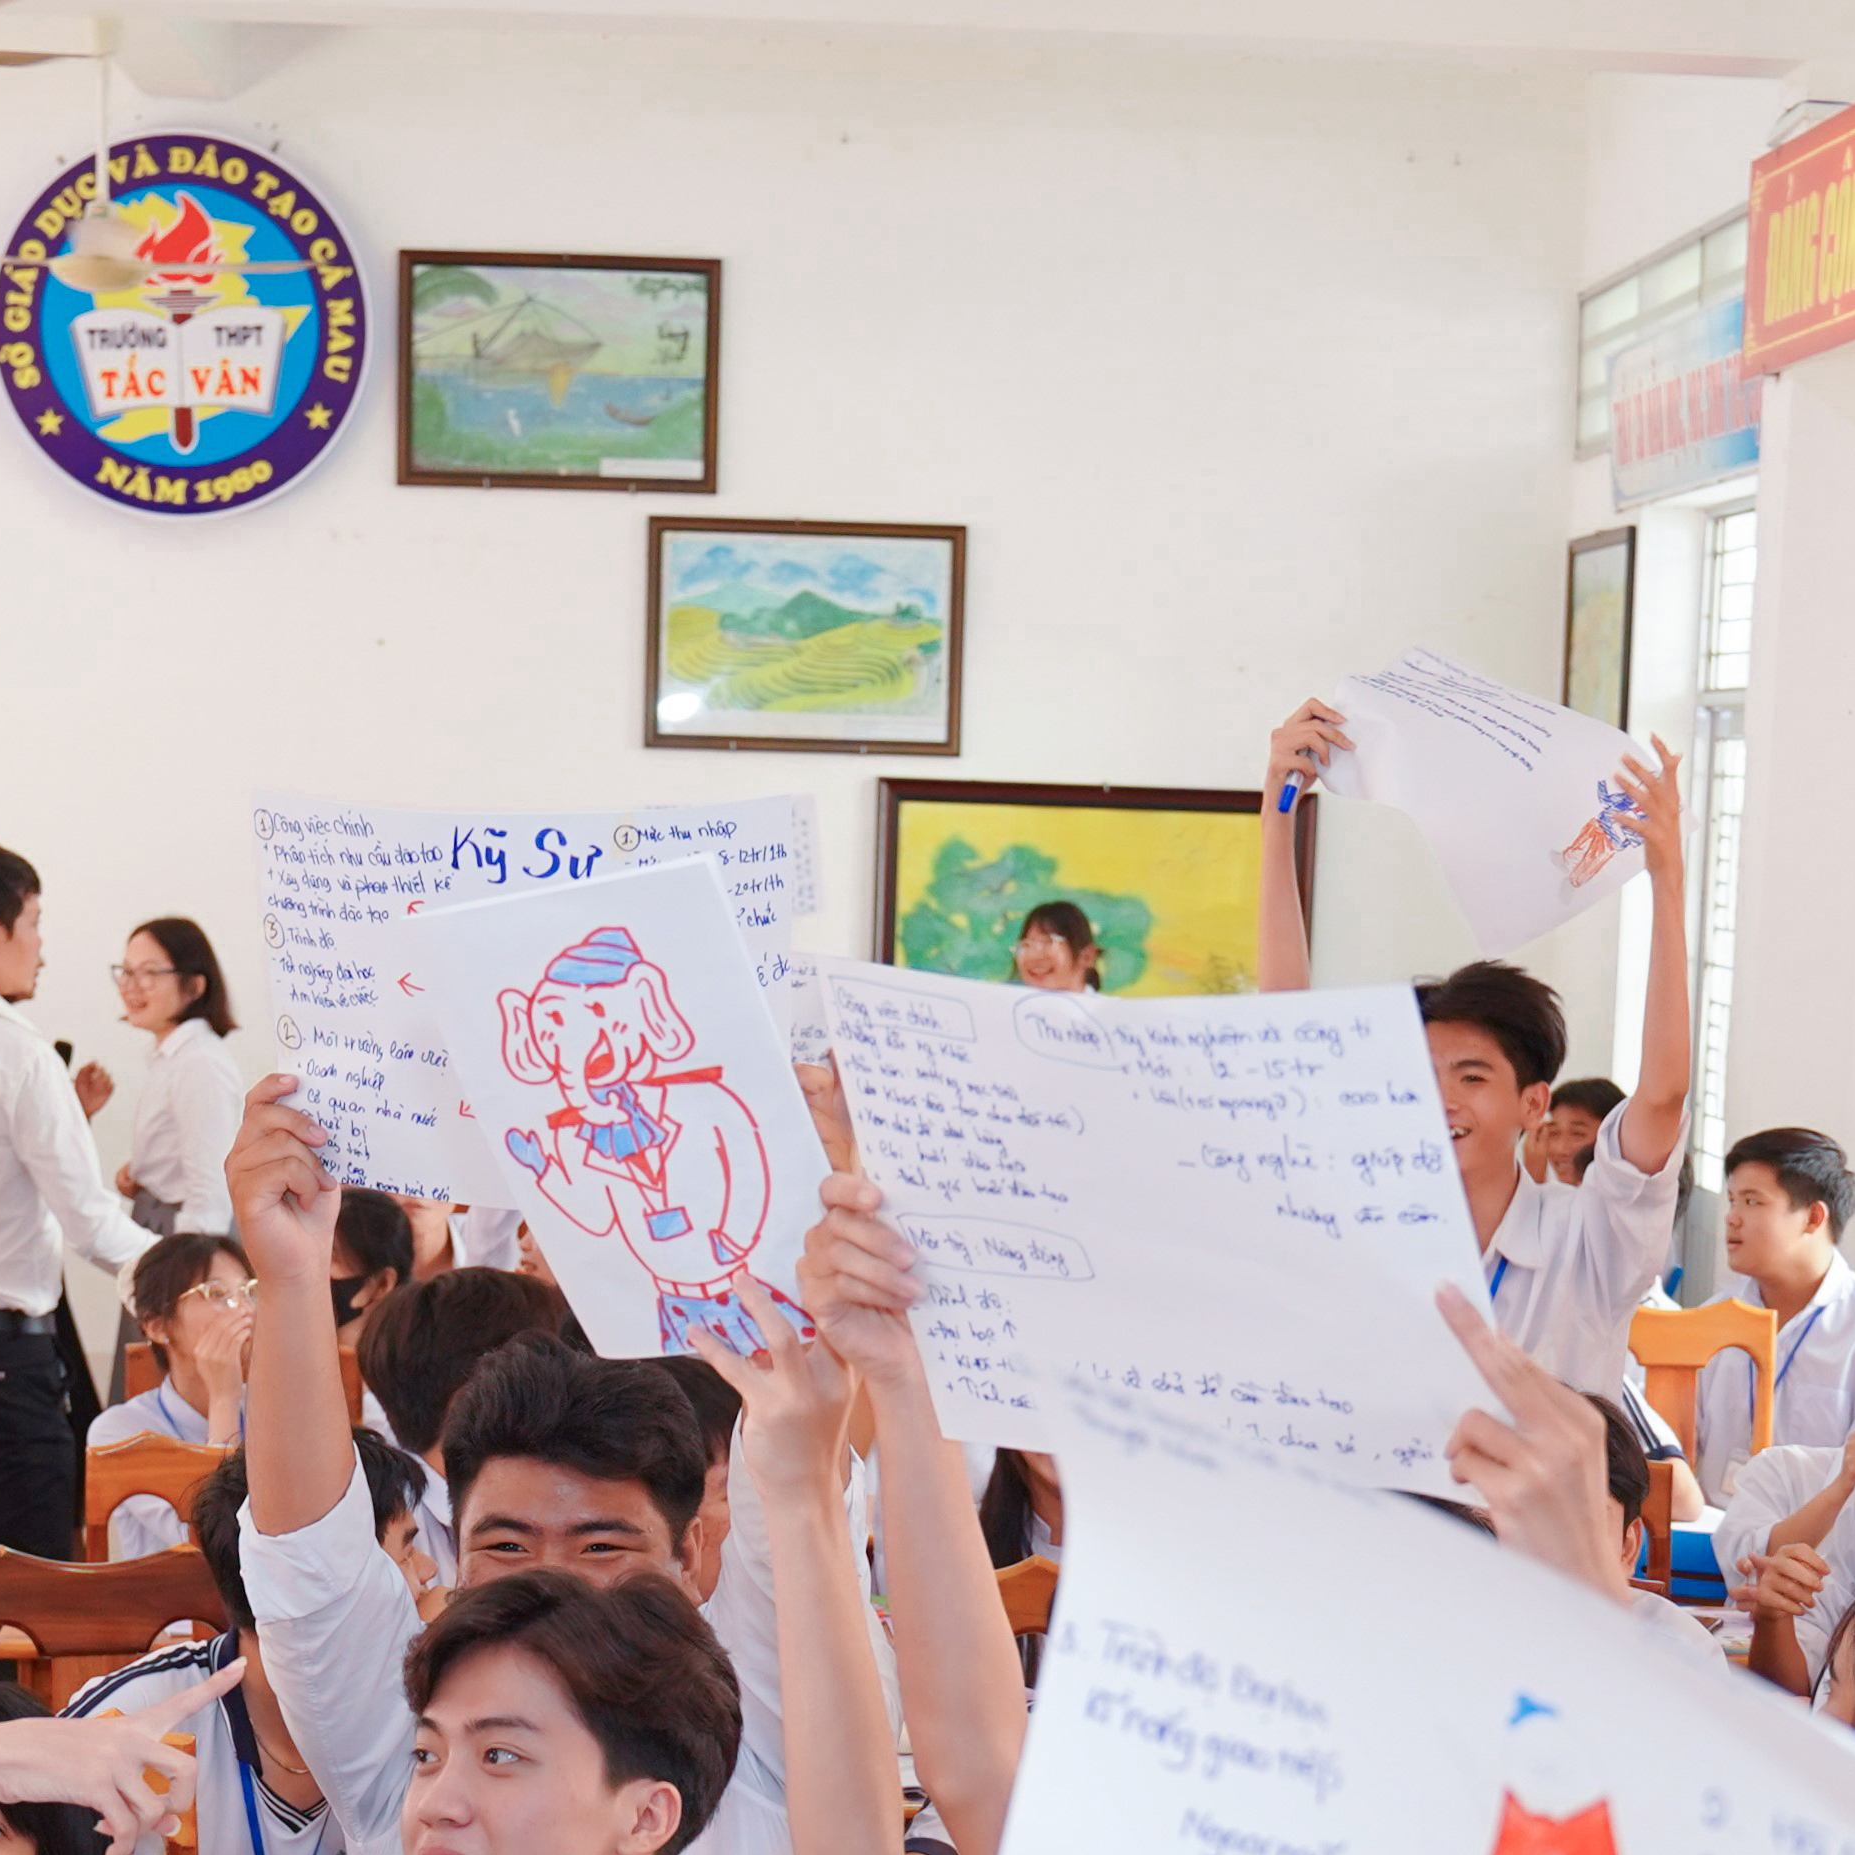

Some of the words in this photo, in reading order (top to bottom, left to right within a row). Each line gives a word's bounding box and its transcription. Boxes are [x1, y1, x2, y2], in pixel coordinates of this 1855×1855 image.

[35, 174, 98, 240] DỤC
[108, 144, 160, 184] VÀ
[251, 171, 319, 234] TẠO
[323, 299, 356, 383] MAU
[214, 325, 264, 348] THPT
[190, 359, 262, 396] VÂN
[96, 457, 188, 505] NĂM
[194, 460, 273, 505] 1980
[272, 813, 302, 841] Công
[668, 825, 692, 840] thu
[698, 820, 738, 842] nhập
[340, 848, 363, 866] nhu
[452, 826, 507, 885] Kỹ
[523, 828, 603, 879] Sư
[337, 876, 352, 891] và
[328, 1096, 365, 1115] quan
[376, 1099, 405, 1120] nhà
